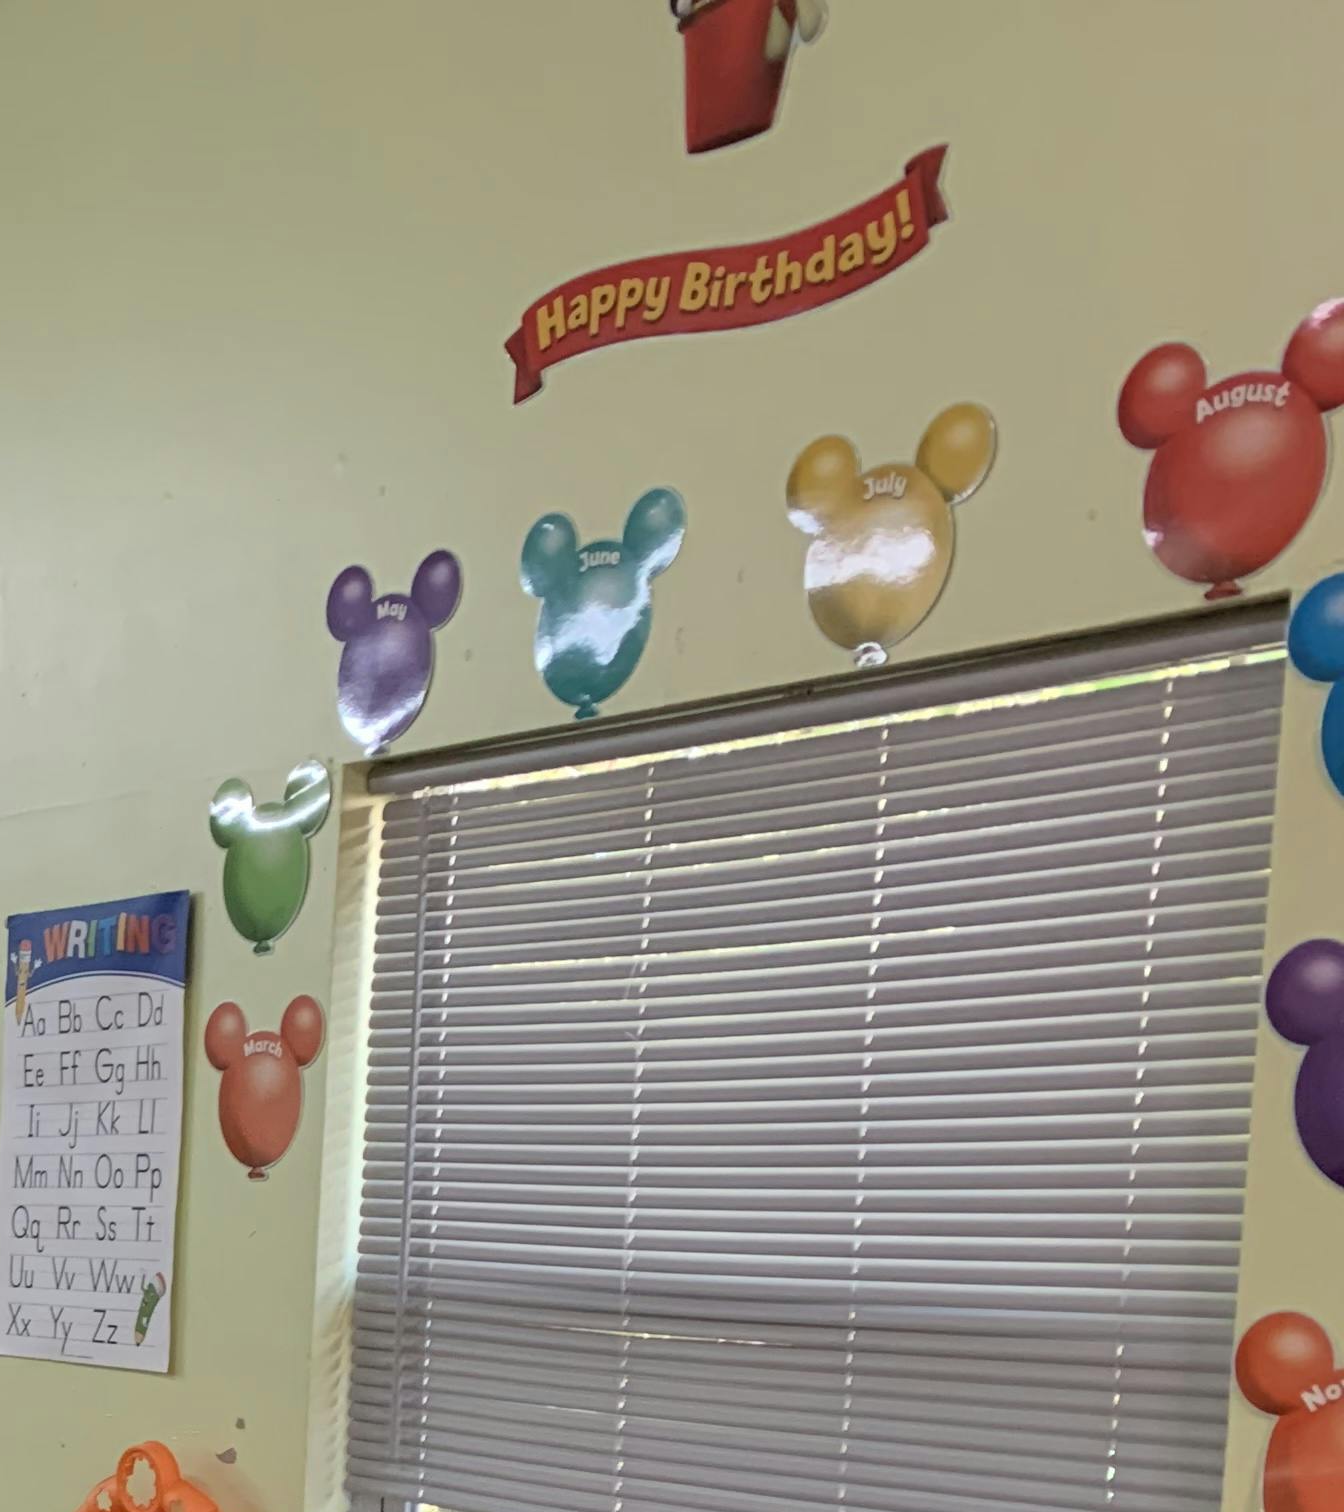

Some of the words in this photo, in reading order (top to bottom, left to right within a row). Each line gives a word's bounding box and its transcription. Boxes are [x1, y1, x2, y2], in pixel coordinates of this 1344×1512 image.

[535, 275, 672, 350] Happy
[678, 189, 916, 313] Birthday!
[1195, 381, 1291, 424] August
[863, 471, 907, 500] July
[579, 551, 621, 572] June
[376, 600, 408, 621] May
[43, 912, 176, 964] WRITING
[21, 1003, 46, 1038] Aa
[58, 999, 82, 1034] Bb
[96, 995, 124, 1031] Cc
[138, 992, 164, 1027] Dd
[24, 1053, 44, 1087] Ee
[60, 1050, 81, 1085] Ff
[95, 1048, 125, 1095] Gg
[136, 1045, 161, 1081] Hh
[243, 1039, 282, 1058] March
[28, 1104, 40, 1137] Ii
[58, 1102, 79, 1149] Jj
[96, 1101, 120, 1136] Kk
[138, 1099, 156, 1134] Ll
[13, 1155, 48, 1188] Mm
[57, 1155, 83, 1188] Nn
[94, 1153, 124, 1189] Oo
[135, 1153, 162, 1203] Pp
[12, 1205, 44, 1253] Qq
[56, 1206, 81, 1239] Rr
[96, 1206, 117, 1241] Ss
[131, 1207, 155, 1241] Tt
[10, 1255, 35, 1288] Uu
[52, 1257, 76, 1290] Vv
[89, 1258, 135, 1293] Ww
[5, 1304, 31, 1336] Xx
[50, 1306, 73, 1355] Yy
[92, 1309, 118, 1344] Zz
[1300, 1379, 1344, 1413] No
